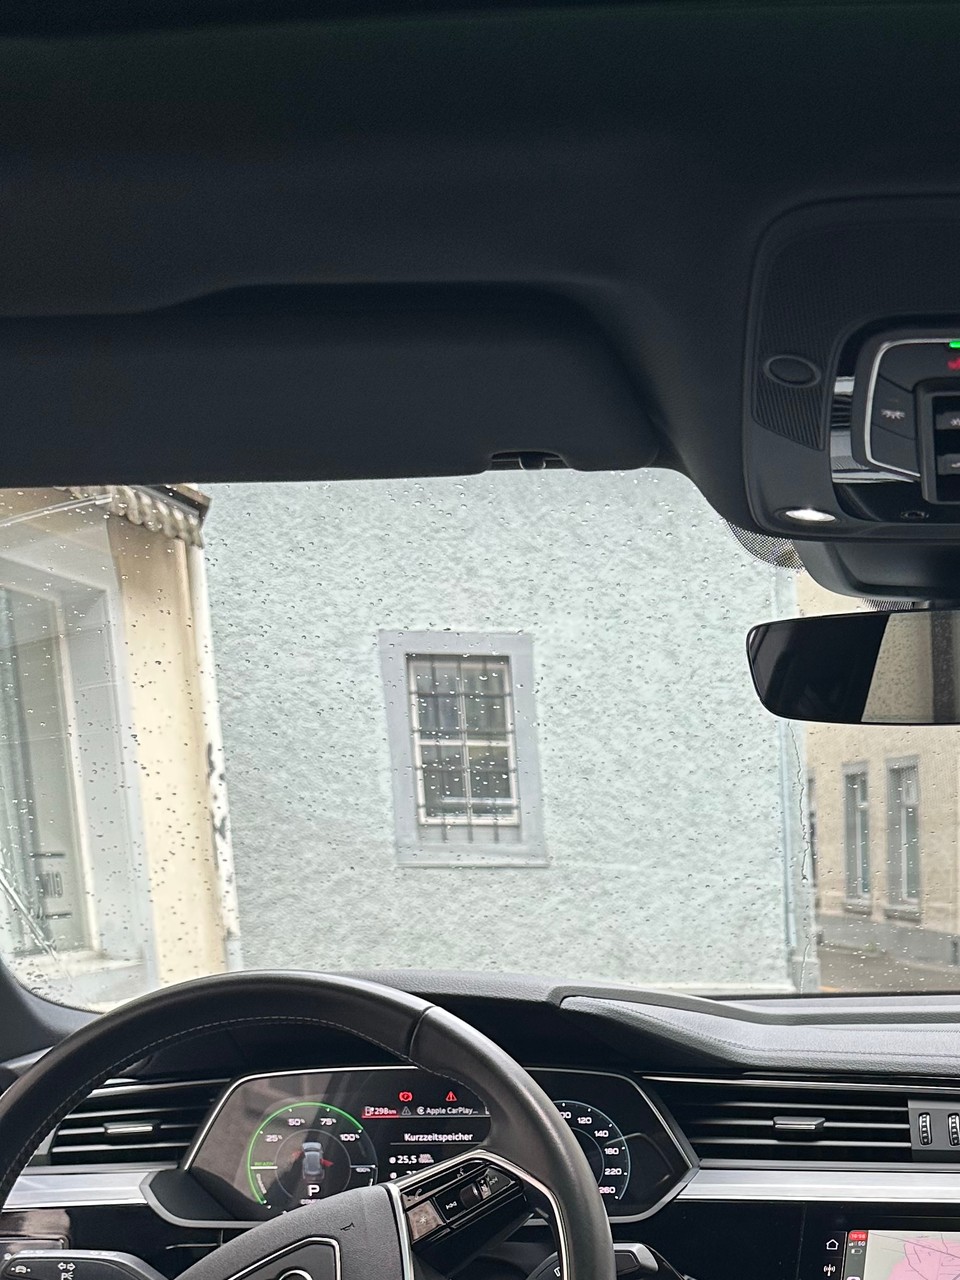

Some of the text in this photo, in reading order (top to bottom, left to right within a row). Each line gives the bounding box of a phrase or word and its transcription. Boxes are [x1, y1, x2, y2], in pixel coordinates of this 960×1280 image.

[426, 1107, 446, 1115] Apple
[404, 1132, 473, 1142] Kurzzeitspeicher
[604, 1168, 622, 1176] 220
[308, 1184, 321, 1197] P
